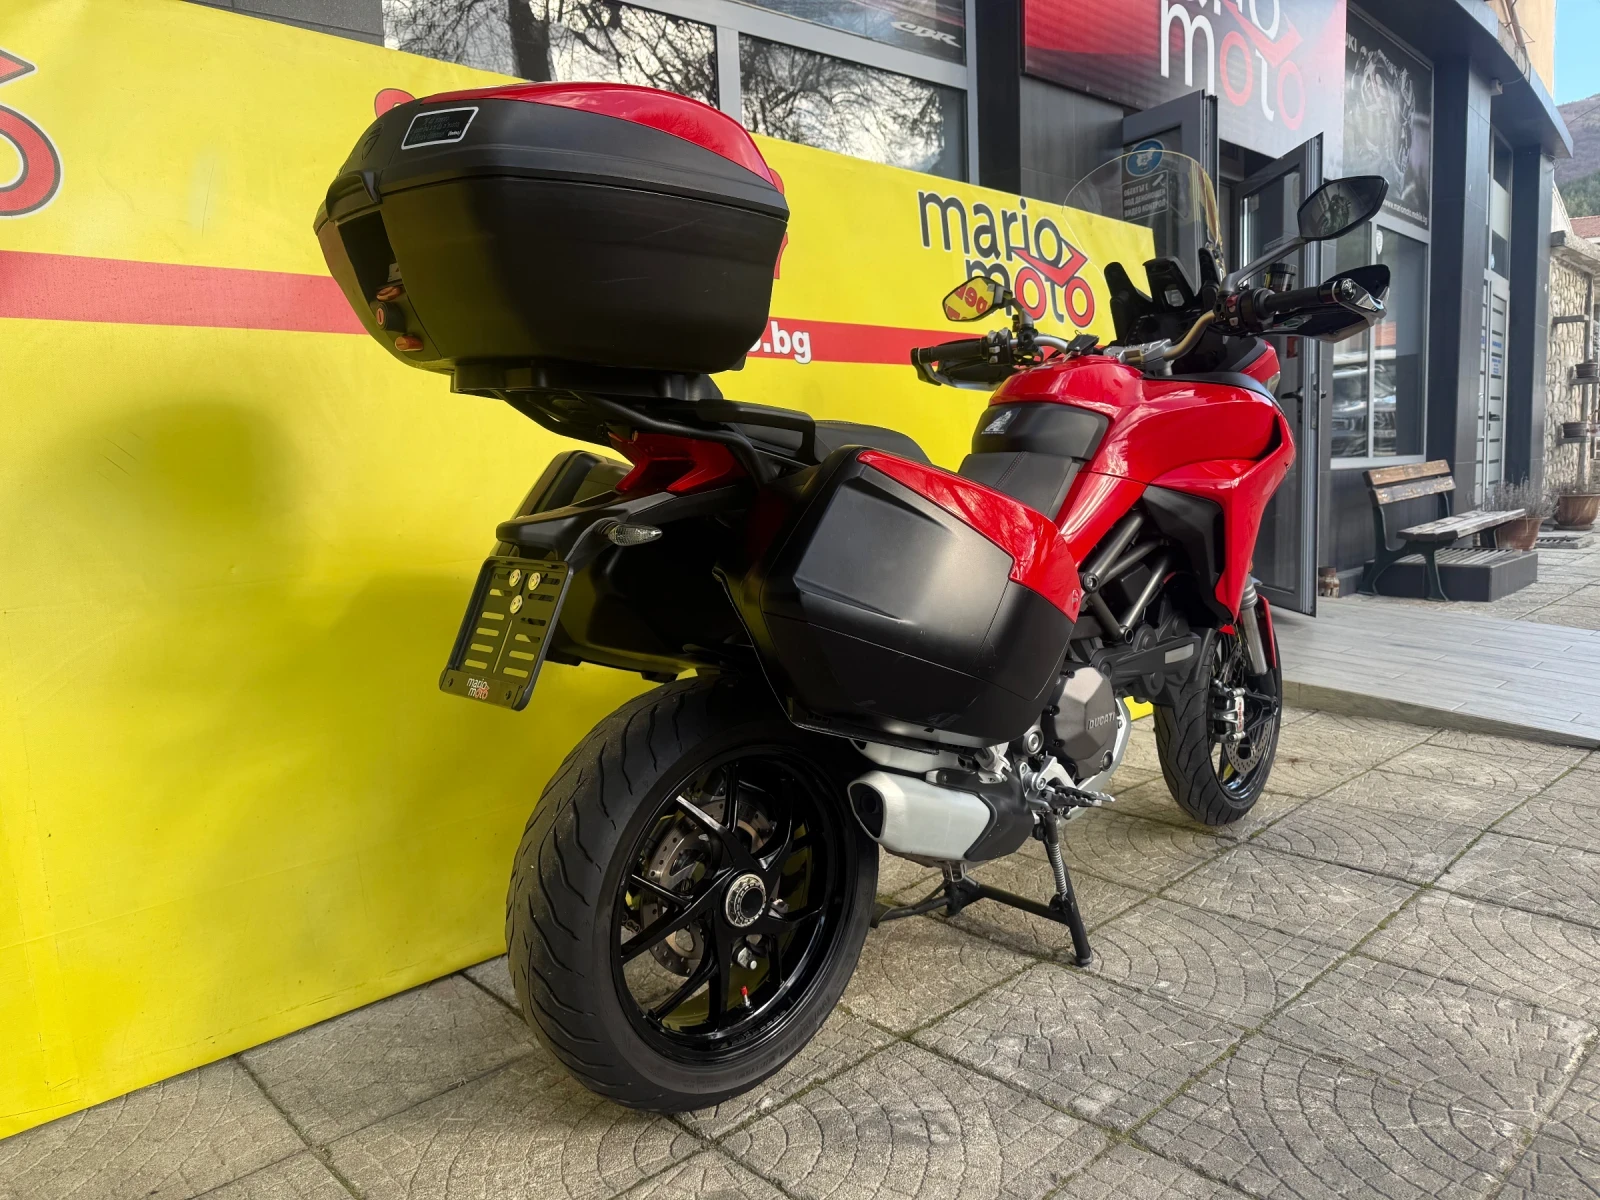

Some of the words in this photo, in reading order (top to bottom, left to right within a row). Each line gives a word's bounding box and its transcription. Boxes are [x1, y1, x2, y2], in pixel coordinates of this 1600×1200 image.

[890, 21, 962, 48] CBR
[1160, 0, 1306, 131] moto
[917, 190, 1063, 268] mario
[965, 258, 1095, 328] moto
[466, 677, 489, 689] mario
[468, 687, 489, 700] moto
[1088, 711, 1116, 730] DUCATI
